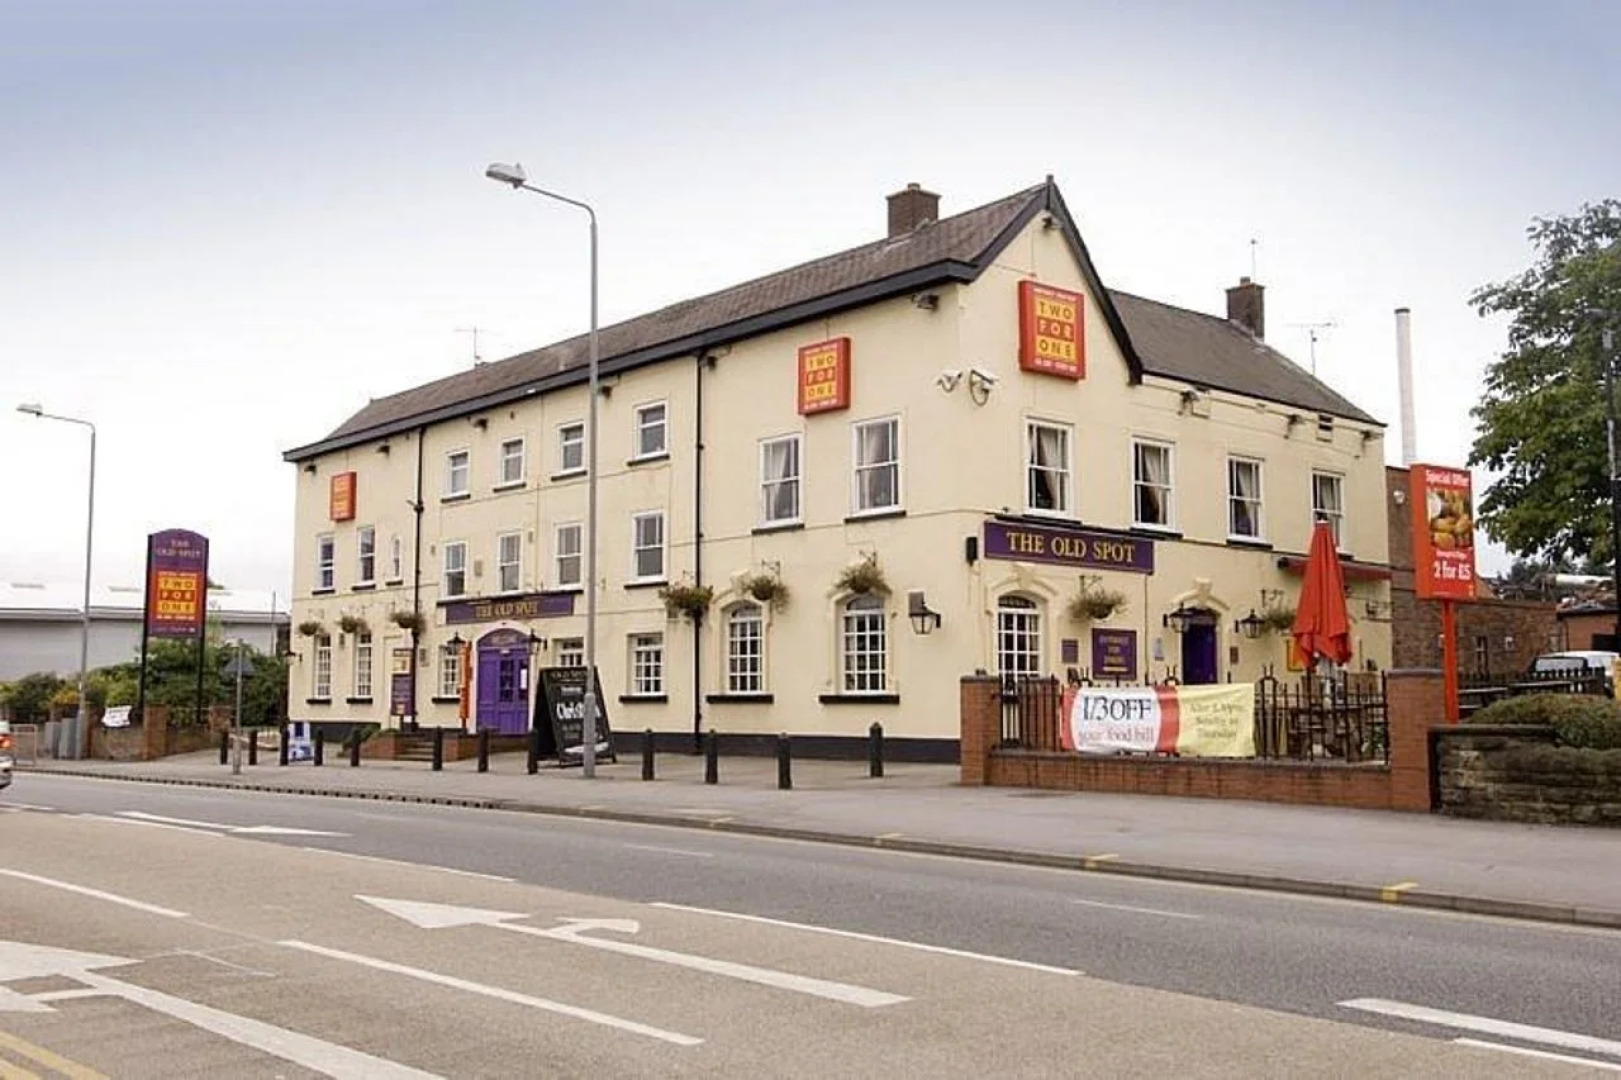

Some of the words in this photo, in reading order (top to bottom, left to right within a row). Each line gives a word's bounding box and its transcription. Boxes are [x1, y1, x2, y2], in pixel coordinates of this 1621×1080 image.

[1040, 301, 1073, 320] TWO
[1040, 320, 1072, 339] FOR
[1040, 339, 1072, 357] ONE
[808, 355, 834, 369] TWO
[807, 383, 833, 397] ONE
[1007, 532, 1045, 554] THE
[1051, 536, 1087, 558] OLD
[1093, 541, 1136, 563] SPOT
[1442, 561, 1457, 579] for
[162, 579, 193, 589] TWO
[494, 603, 513, 617] OLD
[1078, 730, 1104, 747] your
[1107, 725, 1132, 743] food
[1134, 726, 1154, 742] bill
